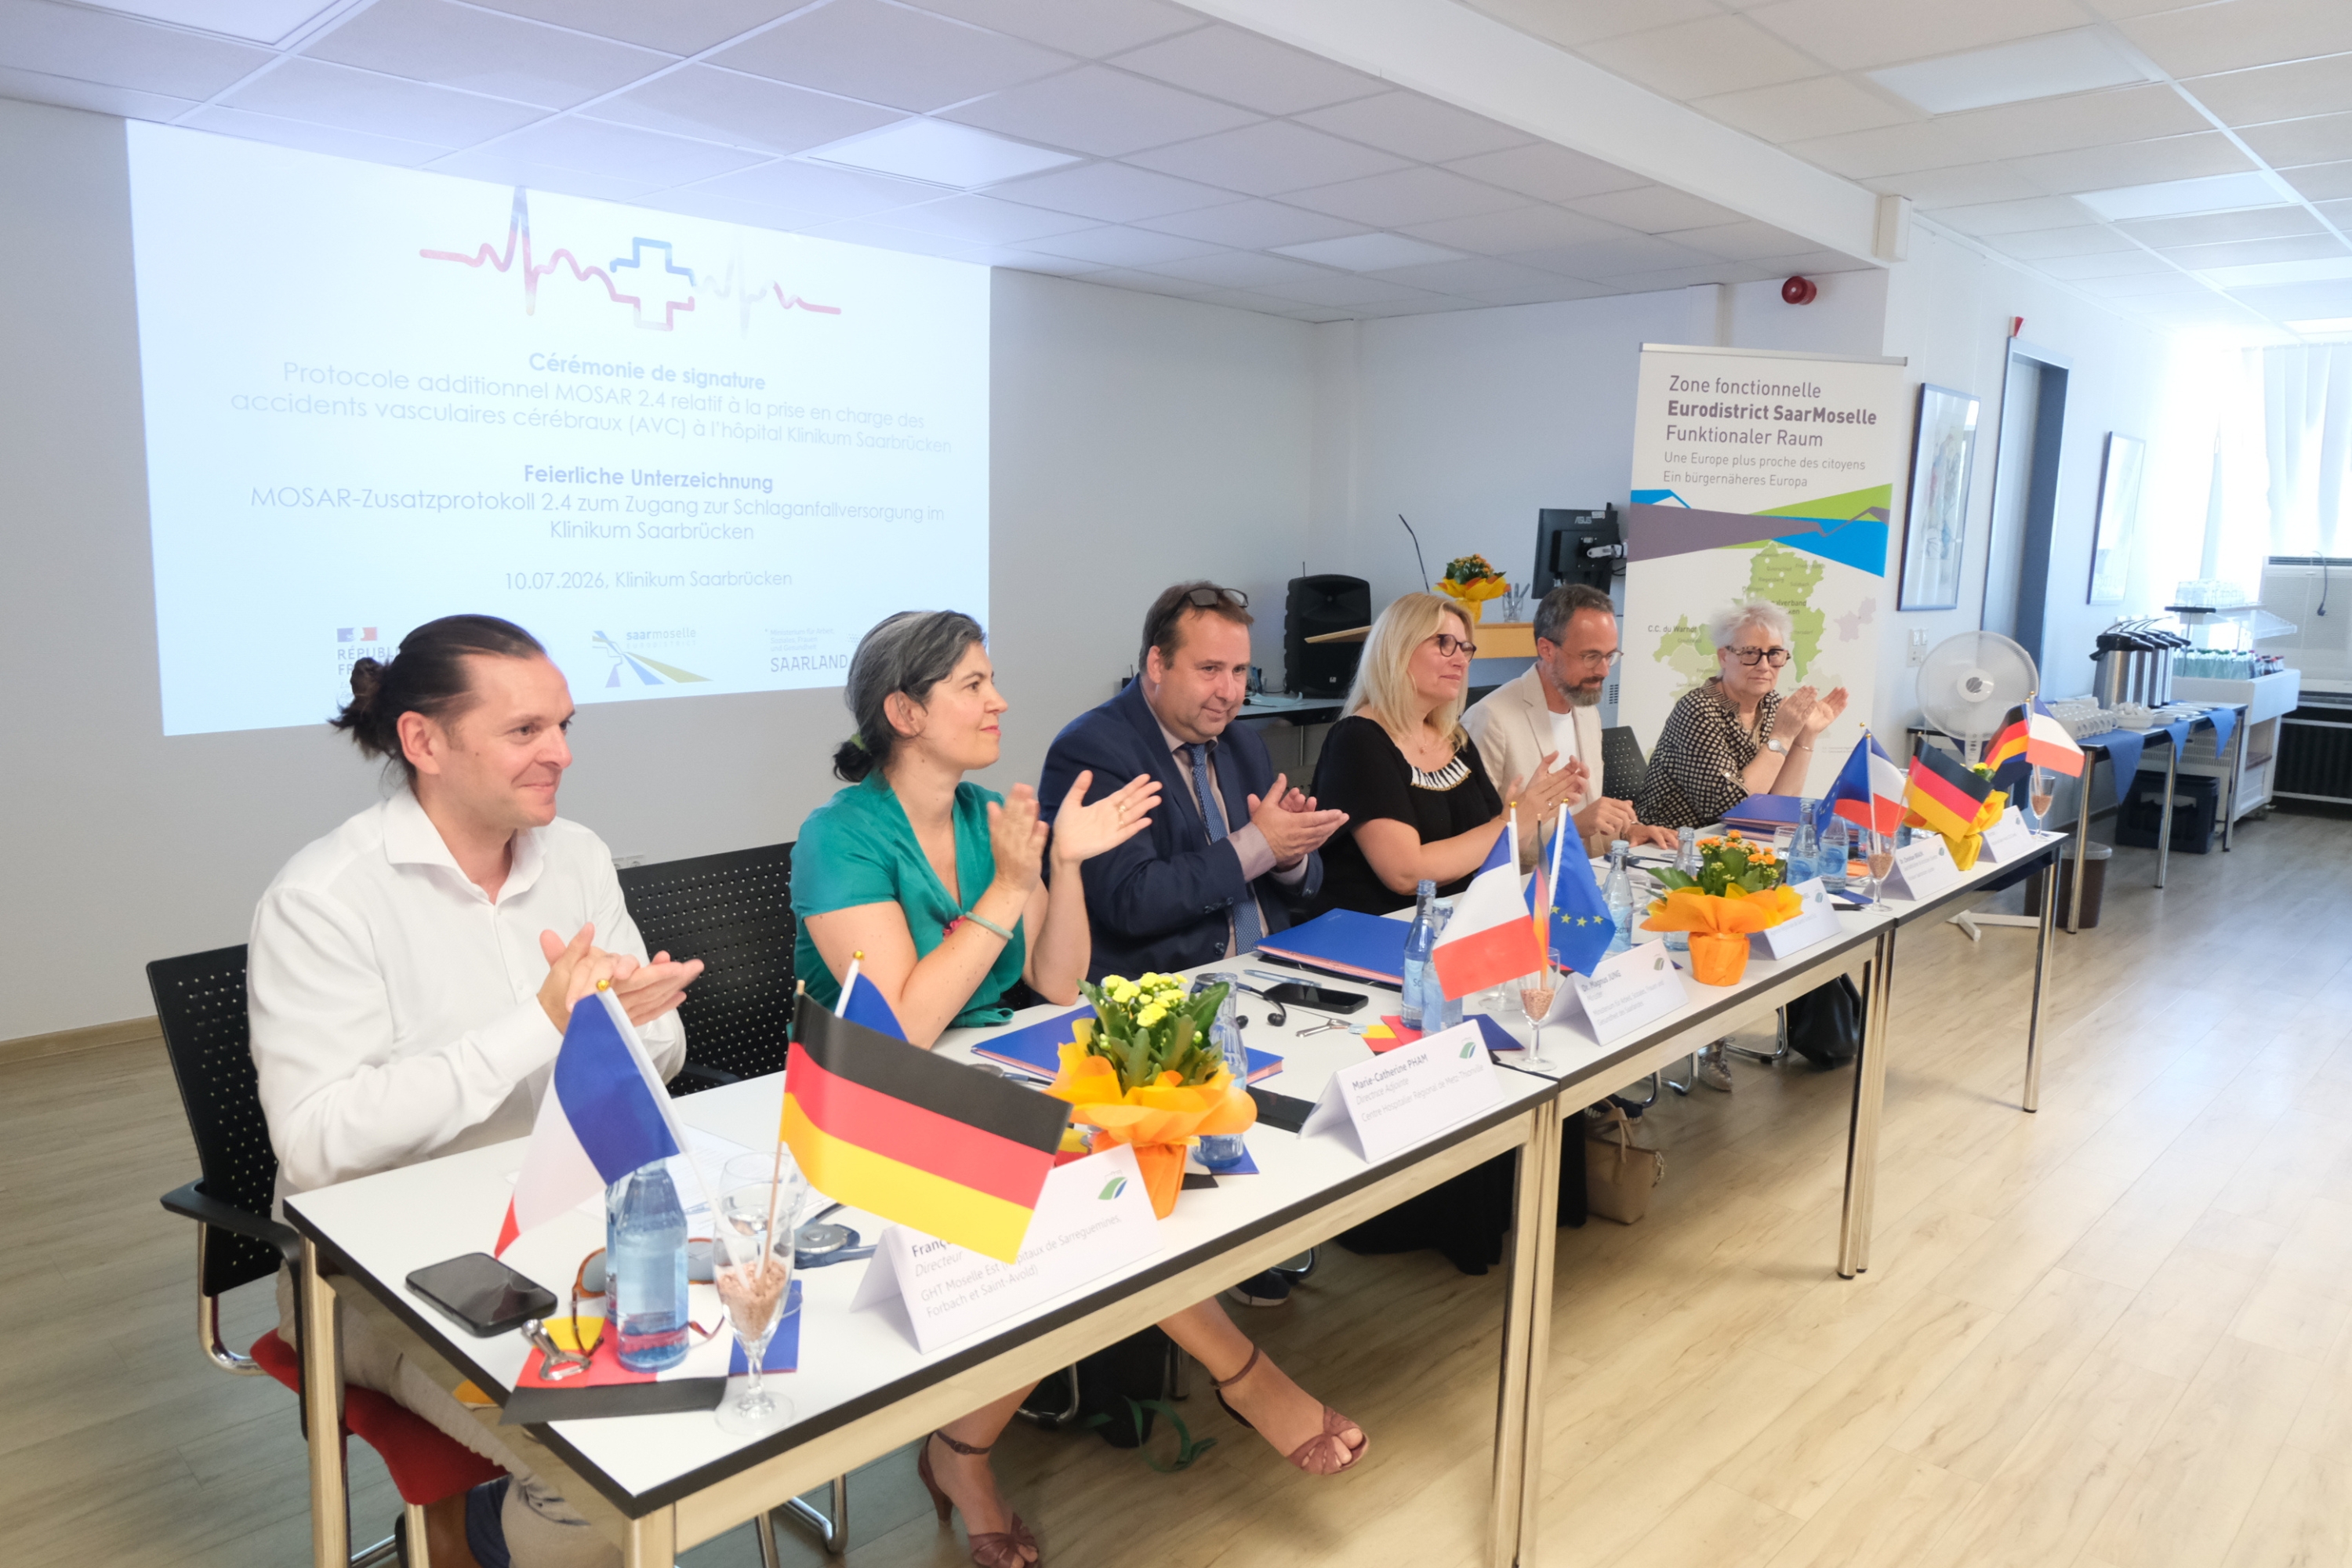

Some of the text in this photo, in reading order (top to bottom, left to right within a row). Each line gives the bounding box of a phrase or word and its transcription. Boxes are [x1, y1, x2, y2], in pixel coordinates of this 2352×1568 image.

[528, 352, 766, 390] Cérémonie de signature
[283, 361, 924, 429] Protocole additionnel MOSAR 2.4 relatif à la prise en charge des
[1669, 375, 1821, 398] Zone fonctionnelle
[230, 393, 367, 418] accidents
[374, 401, 506, 426] vasculaires
[513, 408, 622, 432] cérébraux
[629, 415, 686, 439] (AVC)
[693, 419, 706, 437] à
[788, 427, 852, 446] Klinikum
[856, 430, 953, 454] Saarbrücken
[1668, 400, 1877, 425] Eurodistrict SaarMoselle
[1666, 425, 1823, 447] Funktionaler Raum
[1664, 452, 1866, 472] Une Europe plus proche des citoyens
[524, 464, 774, 495] Feierliche Unterzeichnung
[1664, 470, 1808, 488] Ein bürgernäheres Europa
[250, 486, 945, 524] MOSAR-Zusatzprotokoll 2.4 zum Zugang zur Schlaganfallversorgung im
[550, 520, 755, 540] Klinikum Saarbrücken
[1574, 516, 1592, 524] ASUS
[505, 569, 793, 591] 10.07.2026, Klinikum Saarbrücken
[626, 627, 696, 641] saarmoselle
[337, 644, 401, 661] RÉPUBLI
[770, 654, 848, 673] SAARLAND
[1352, 1054, 1428, 1091] Marie-Catherine PHAM
[1356, 1077, 1410, 1105] Directrice Adjointe
[1361, 1107, 1382, 1123] Centre
[912, 1240, 952, 1258] Franç
[915, 1249, 964, 1277] Directeur
[920, 1283, 943, 1302] GHT
[945, 1269, 984, 1293] Moselle
[984, 1261, 1001, 1276] Est
[1045, 1240, 1058, 1251] de
[926, 1264, 1040, 1319] Forbach et Saint-Avold)
